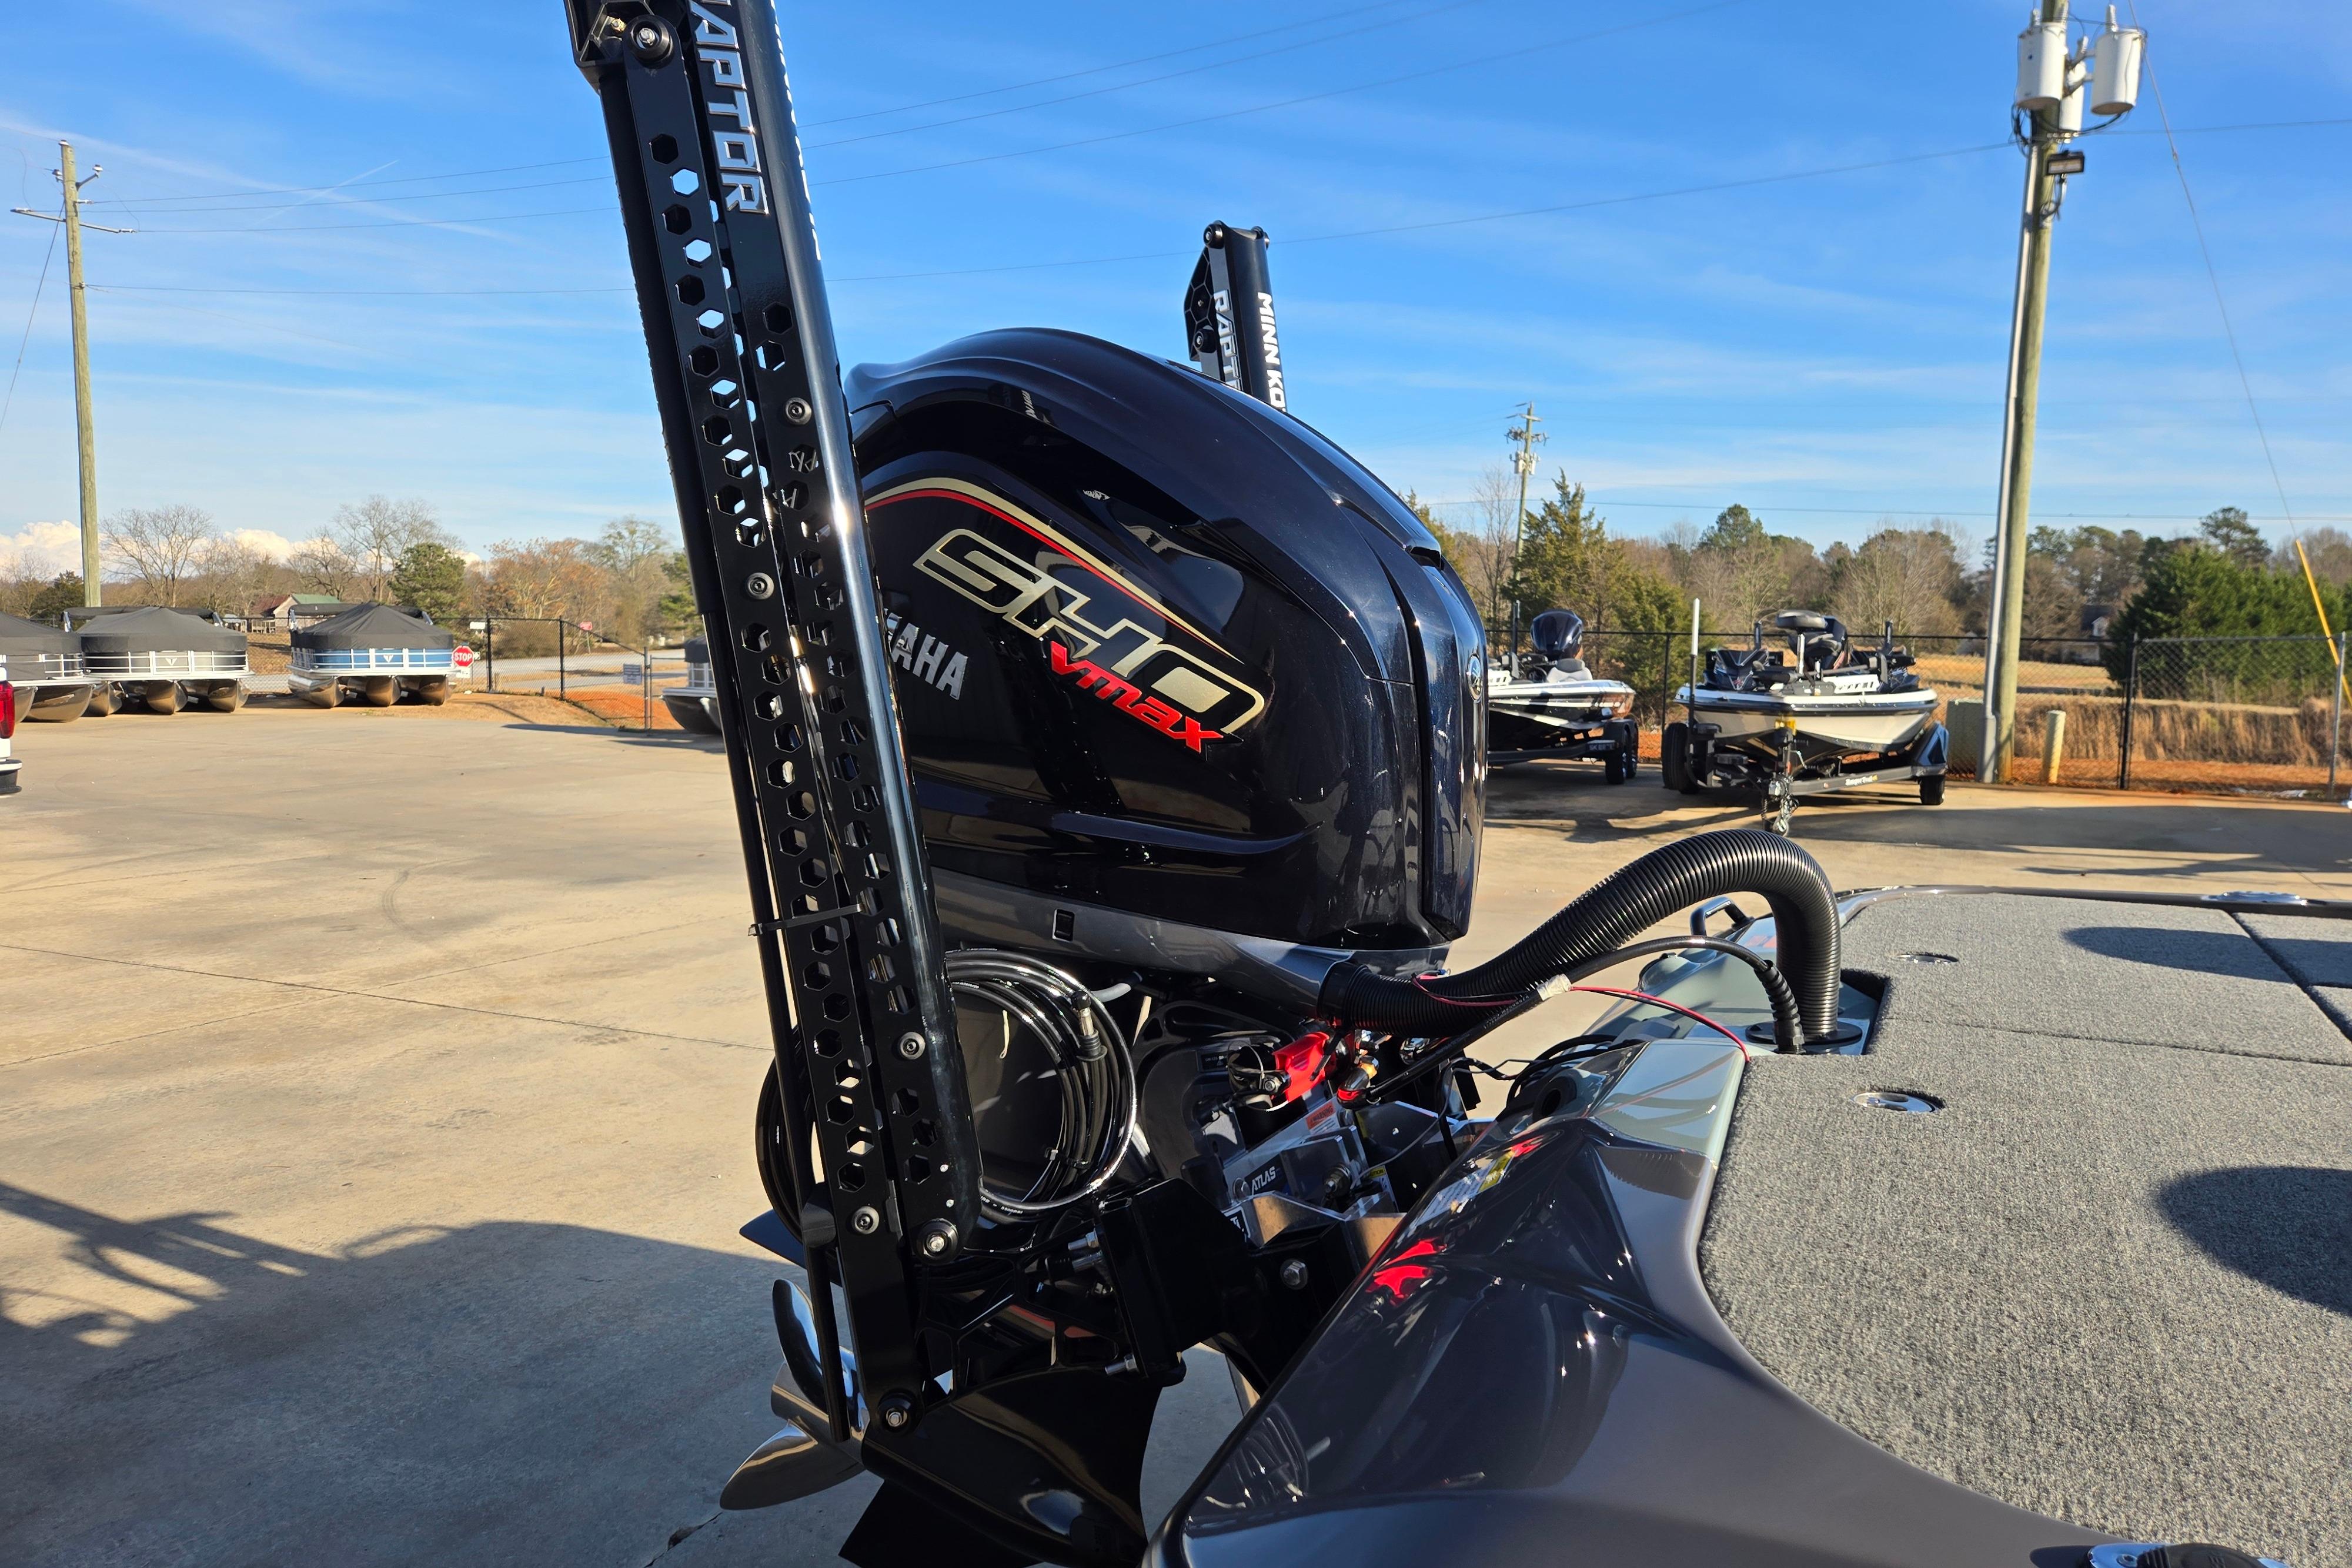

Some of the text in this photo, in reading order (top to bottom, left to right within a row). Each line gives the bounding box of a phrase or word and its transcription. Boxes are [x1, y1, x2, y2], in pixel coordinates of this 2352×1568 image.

[689, 0, 769, 215] APTOR
[1258, 292, 1287, 412] MINN KO
[454, 652, 473, 662] STOP
[913, 529, 1265, 734] SHO
[1251, 1166, 1276, 1195] ATLAS
